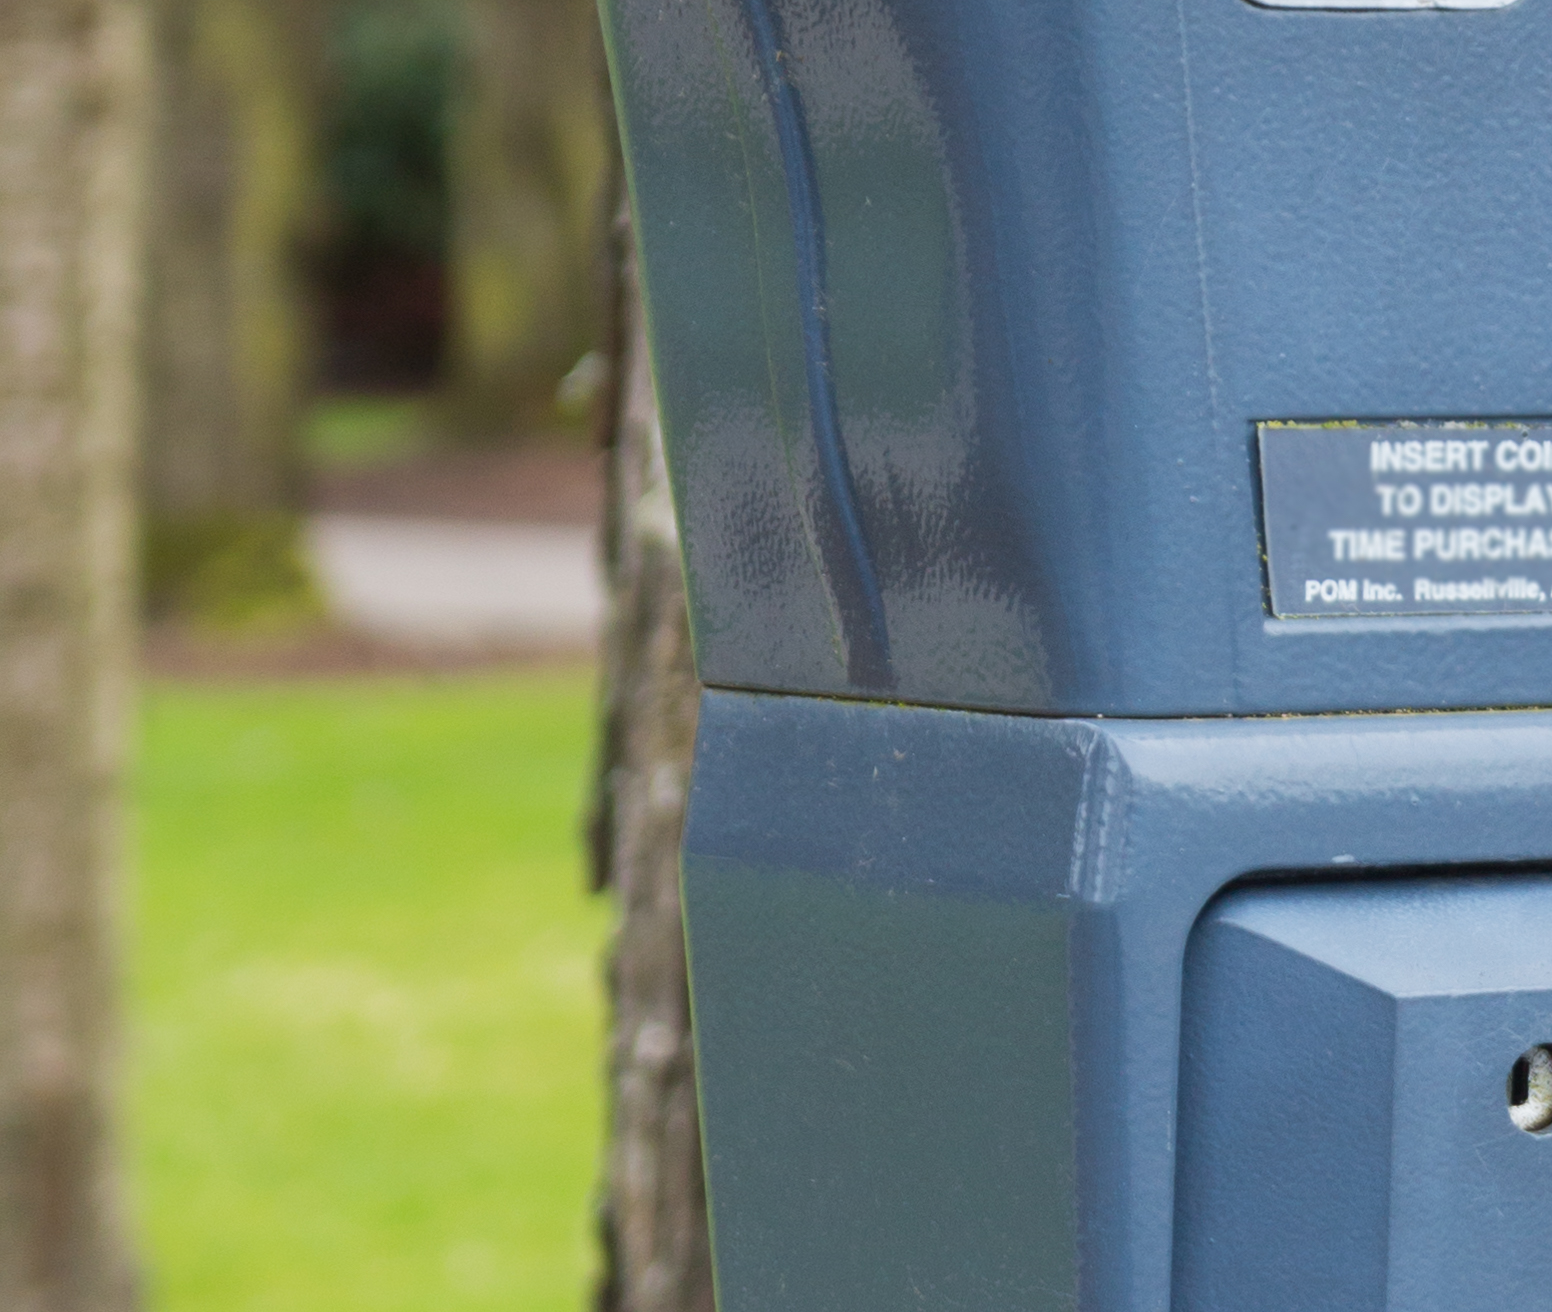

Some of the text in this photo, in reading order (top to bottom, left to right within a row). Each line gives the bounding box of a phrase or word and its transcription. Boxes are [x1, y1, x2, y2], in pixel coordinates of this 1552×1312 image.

[1371, 440, 1489, 472] INSERT
[1376, 485, 1422, 516] TO
[1329, 530, 1405, 560] TIME
[1305, 580, 1357, 603] POM
[1363, 579, 1402, 602] Inc.
[1414, 577, 1546, 602] Russellville,
